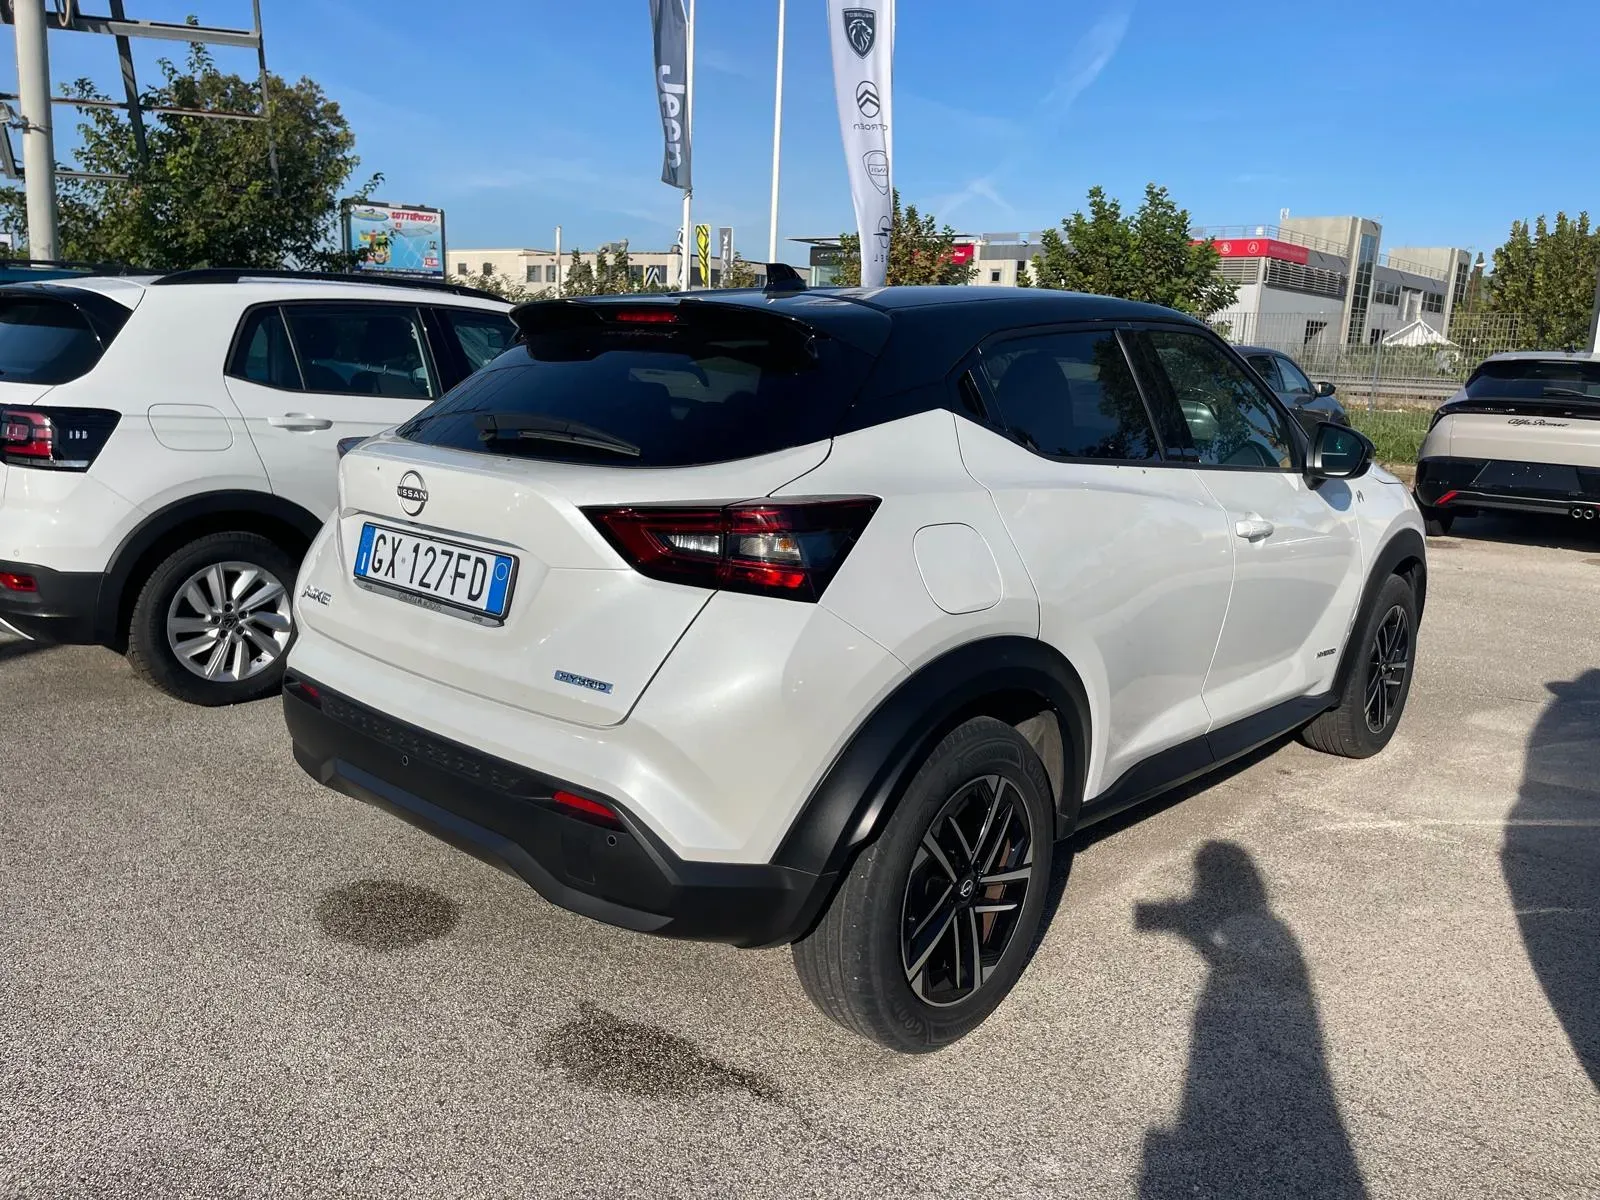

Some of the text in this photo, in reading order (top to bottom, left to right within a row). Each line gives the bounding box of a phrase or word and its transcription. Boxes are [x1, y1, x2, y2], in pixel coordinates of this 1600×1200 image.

[657, 64, 685, 169] Jeep
[1508, 418, 1570, 428] Alfa Romeo
[398, 488, 427, 500] NISSAN
[371, 533, 488, 602] GX 127FD
[559, 671, 607, 691] HYBRID
